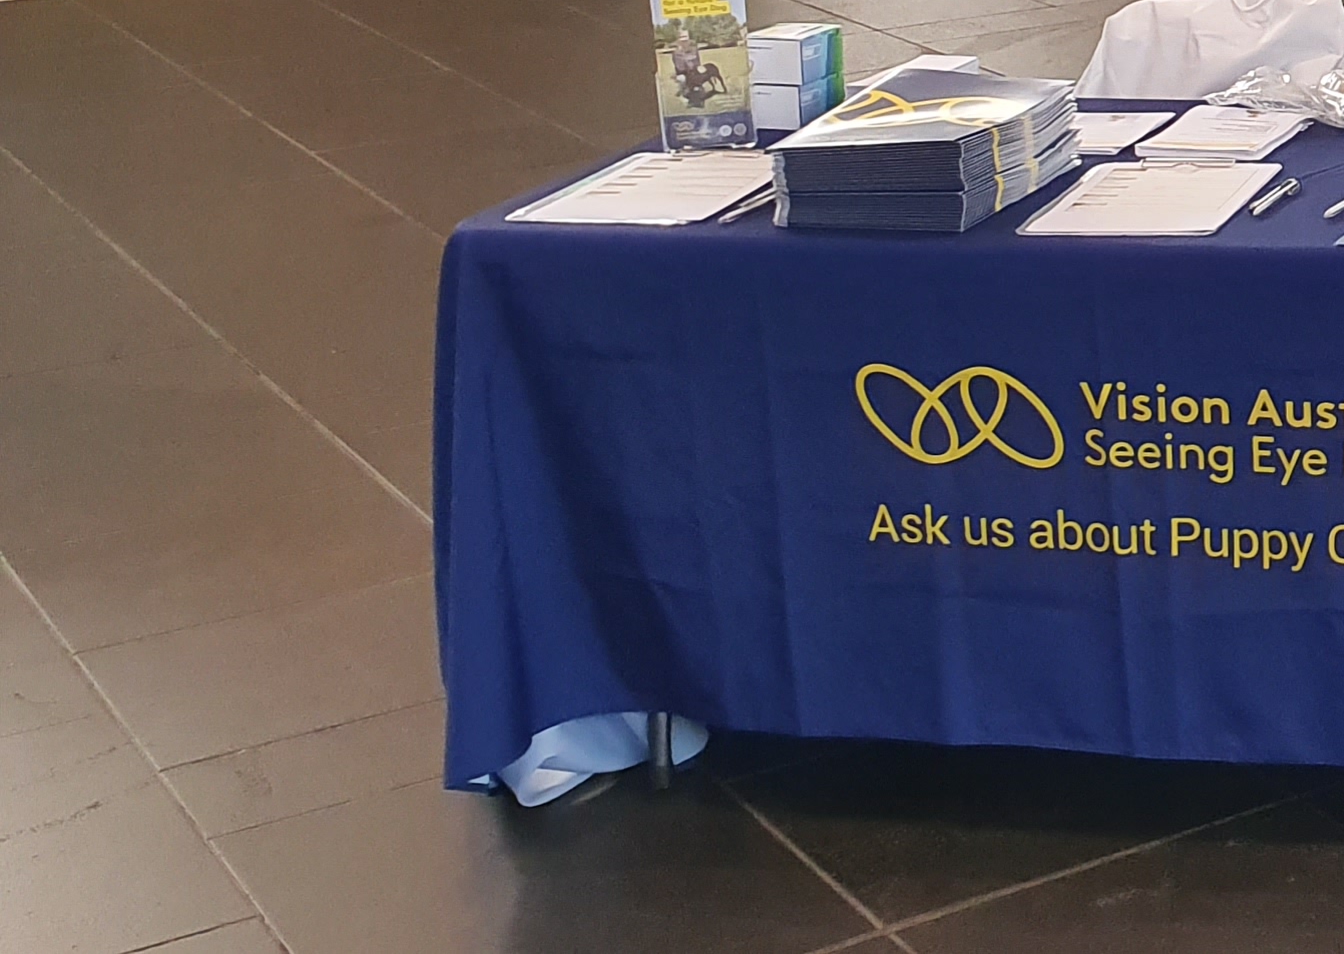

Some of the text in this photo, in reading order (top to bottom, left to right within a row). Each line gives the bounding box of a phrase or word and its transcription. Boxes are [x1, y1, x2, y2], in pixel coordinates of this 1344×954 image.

[1079, 381, 1230, 425] Vision
[1085, 428, 1234, 484] Seeing
[1252, 435, 1328, 486] Eye
[869, 503, 951, 545] Ask
[963, 516, 1015, 548] us
[1029, 509, 1157, 556] about
[1170, 517, 1314, 572] Puppy
